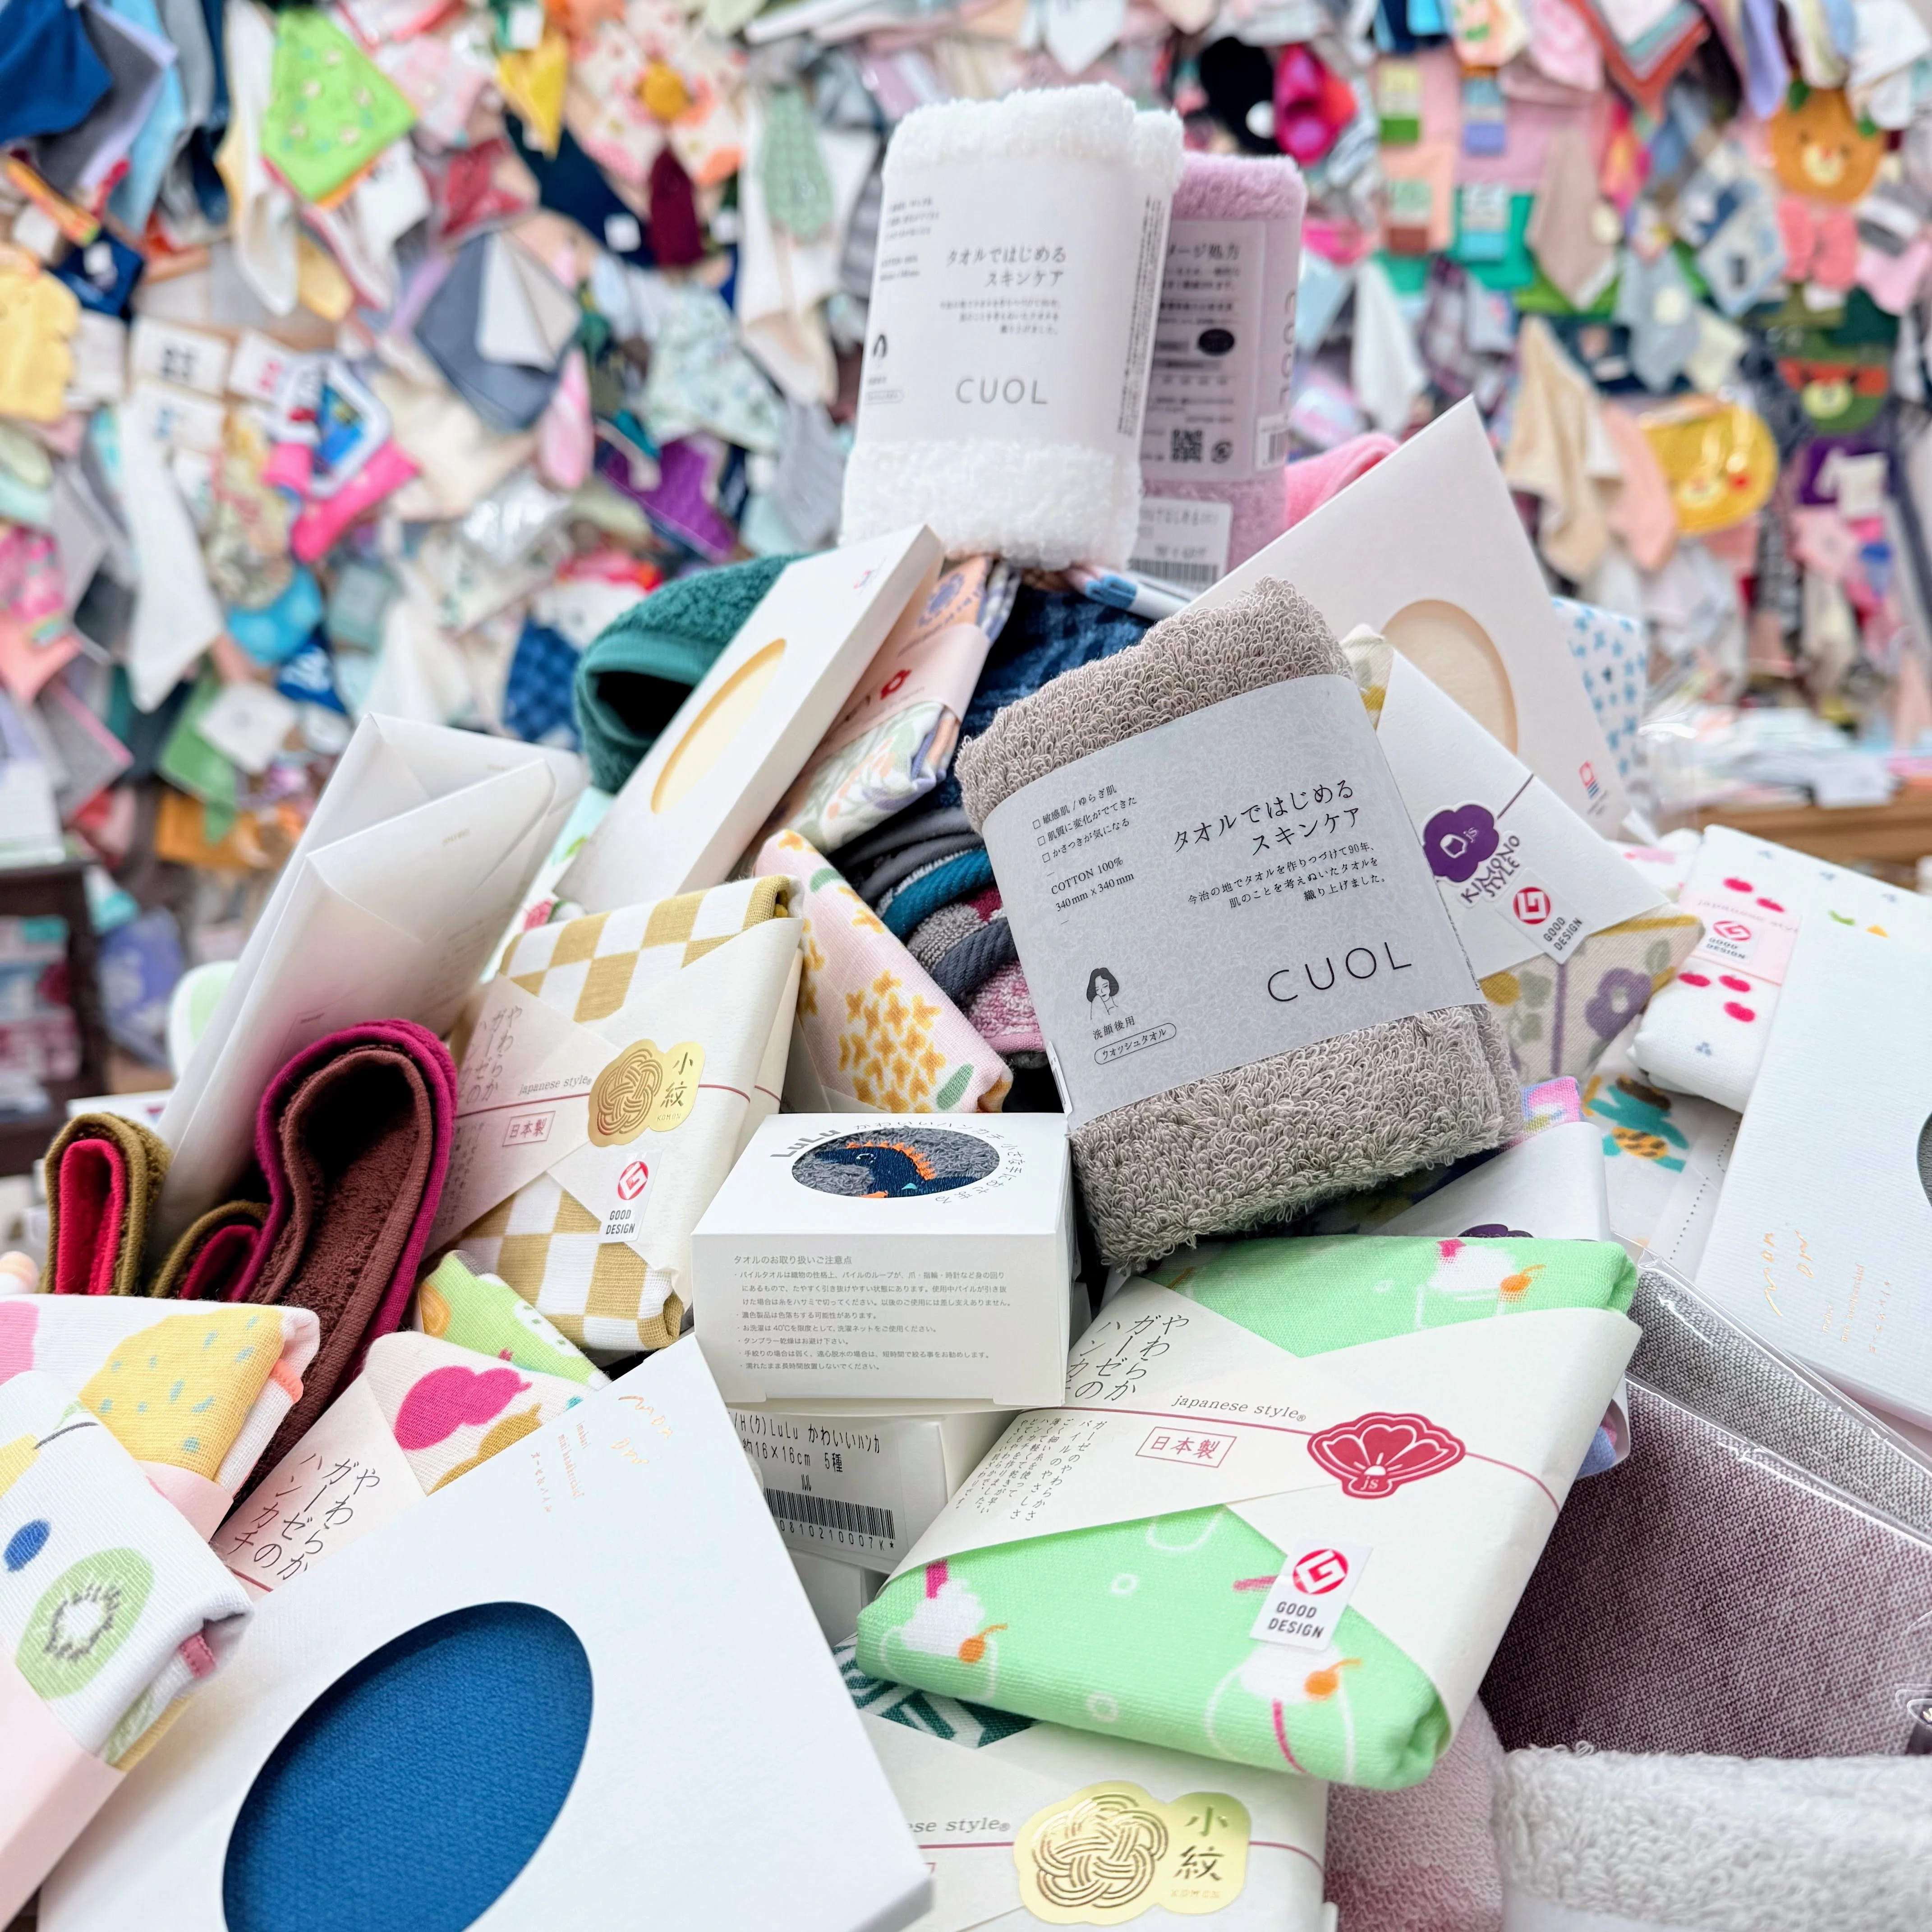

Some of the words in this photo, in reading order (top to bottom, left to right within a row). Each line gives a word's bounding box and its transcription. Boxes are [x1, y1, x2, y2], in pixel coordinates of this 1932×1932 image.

[947, 245, 1066, 267] タオルではじめる
[985, 268, 1064, 287] スキンケア
[956, 378, 1048, 405] CUOL
[1047, 796, 1137, 842] 肌質に変化がでてきた
[1174, 780, 1353, 852] タオルではじめる
[1052, 818, 1130, 858] かさつきが気になる
[1252, 808, 1359, 856] スキンケア
[1051, 869, 1094, 895] COTTON
[1097, 856, 1123, 874] 100%
[1229, 857, 1378, 908] 肌のことを考えぬいたタオルを
[1460, 835, 1520, 903] KIMONO
[1484, 856, 1520, 897] STYLE
[1303, 874, 1385, 901] 織り上げました。
[1543, 917, 1565, 942] GOOD
[1553, 917, 1583, 951] DESIGN
[1709, 937, 1739, 950] GOOD
[1706, 943, 1746, 959] DESIGN
[1267, 942, 1412, 1002] CUOL
[1092, 1016, 1135, 1040] 洗顔後用
[518, 1078, 561, 1096] japanese
[660, 1051, 694, 1109] 小紋
[509, 1118, 547, 1139] 日本製
[657, 1113, 681, 1122] KOMON
[770, 1128, 842, 1158] LuLu
[609, 1209, 632, 1221] GOOD
[606, 1223, 636, 1236] DESIGN
[734, 1256, 852, 1265] タオルのお取り扱いご注意点
[1075, 1315, 1162, 1399] ガーゼの
[1104, 1315, 1189, 1401] やわらか
[1171, 1395, 1248, 1412] japanese
[1009, 1419, 1074, 1497] ごく細い糸を使って
[1150, 1435, 1221, 1460] 日本製
[824, 1452, 843, 1472] 5種
[1010, 1420, 1093, 1519] パイルのやさしさ
[1026, 1421, 1108, 1521] ガーゼのやわらかさ
[1361, 1476, 1379, 1490] js
[227, 1453, 322, 1555] ハンカチ
[253, 1458, 359, 1568] ガーゼの
[277, 1468, 380, 1580] やわらか
[1276, 1601, 1317, 1619] GOOD
[1268, 1618, 1324, 1639] DESIGN
[1173, 1805, 1230, 1881] 小紋
[1170, 1889, 1221, 1899] KOMON
